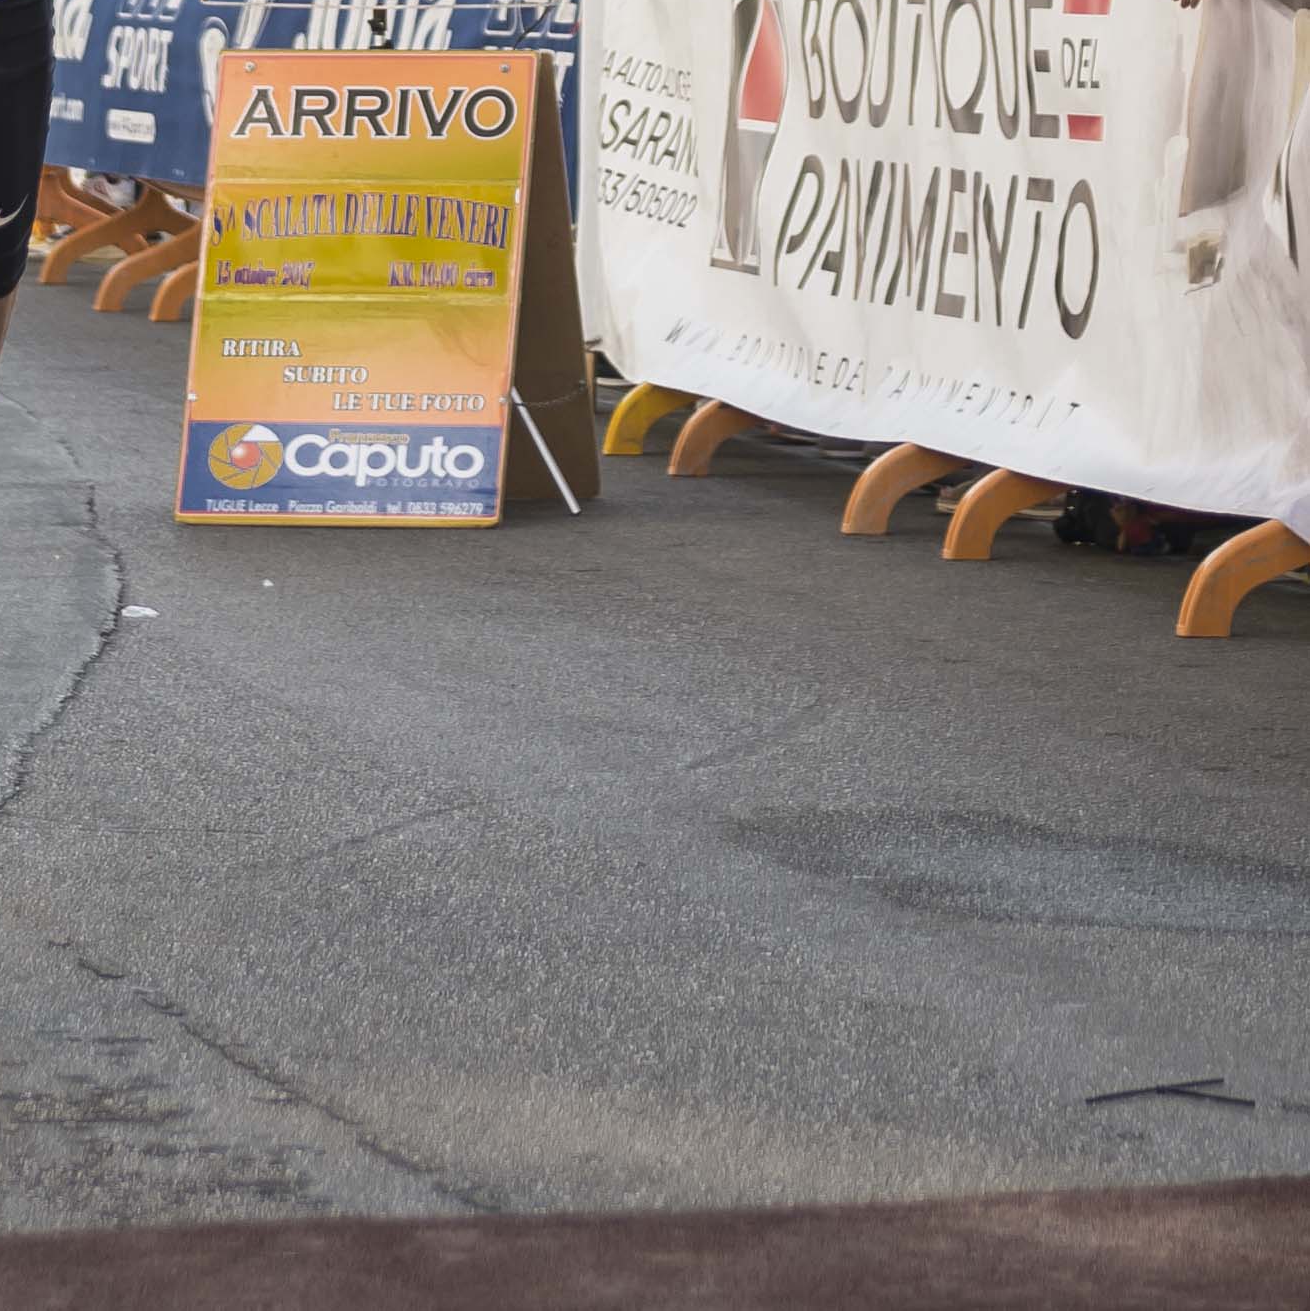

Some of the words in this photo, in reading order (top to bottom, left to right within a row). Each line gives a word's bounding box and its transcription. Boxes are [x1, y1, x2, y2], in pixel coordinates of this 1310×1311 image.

[101, 24, 174, 94] SPORT
[1061, 36, 1101, 90] DEL
[230, 85, 517, 140] ARRIVO
[241, 193, 337, 241] SCALATA
[343, 192, 420, 237] DELLE
[425, 195, 512, 250] VENERI
[774, 155, 1101, 341] PAVIMENTO
[221, 338, 302, 358] RITIRA
[282, 366, 369, 385] SUBITO
[332, 393, 362, 411] LE
[367, 393, 416, 411] TUE
[420, 393, 485, 412] FOTO
[284, 433, 485, 487] Caputo
